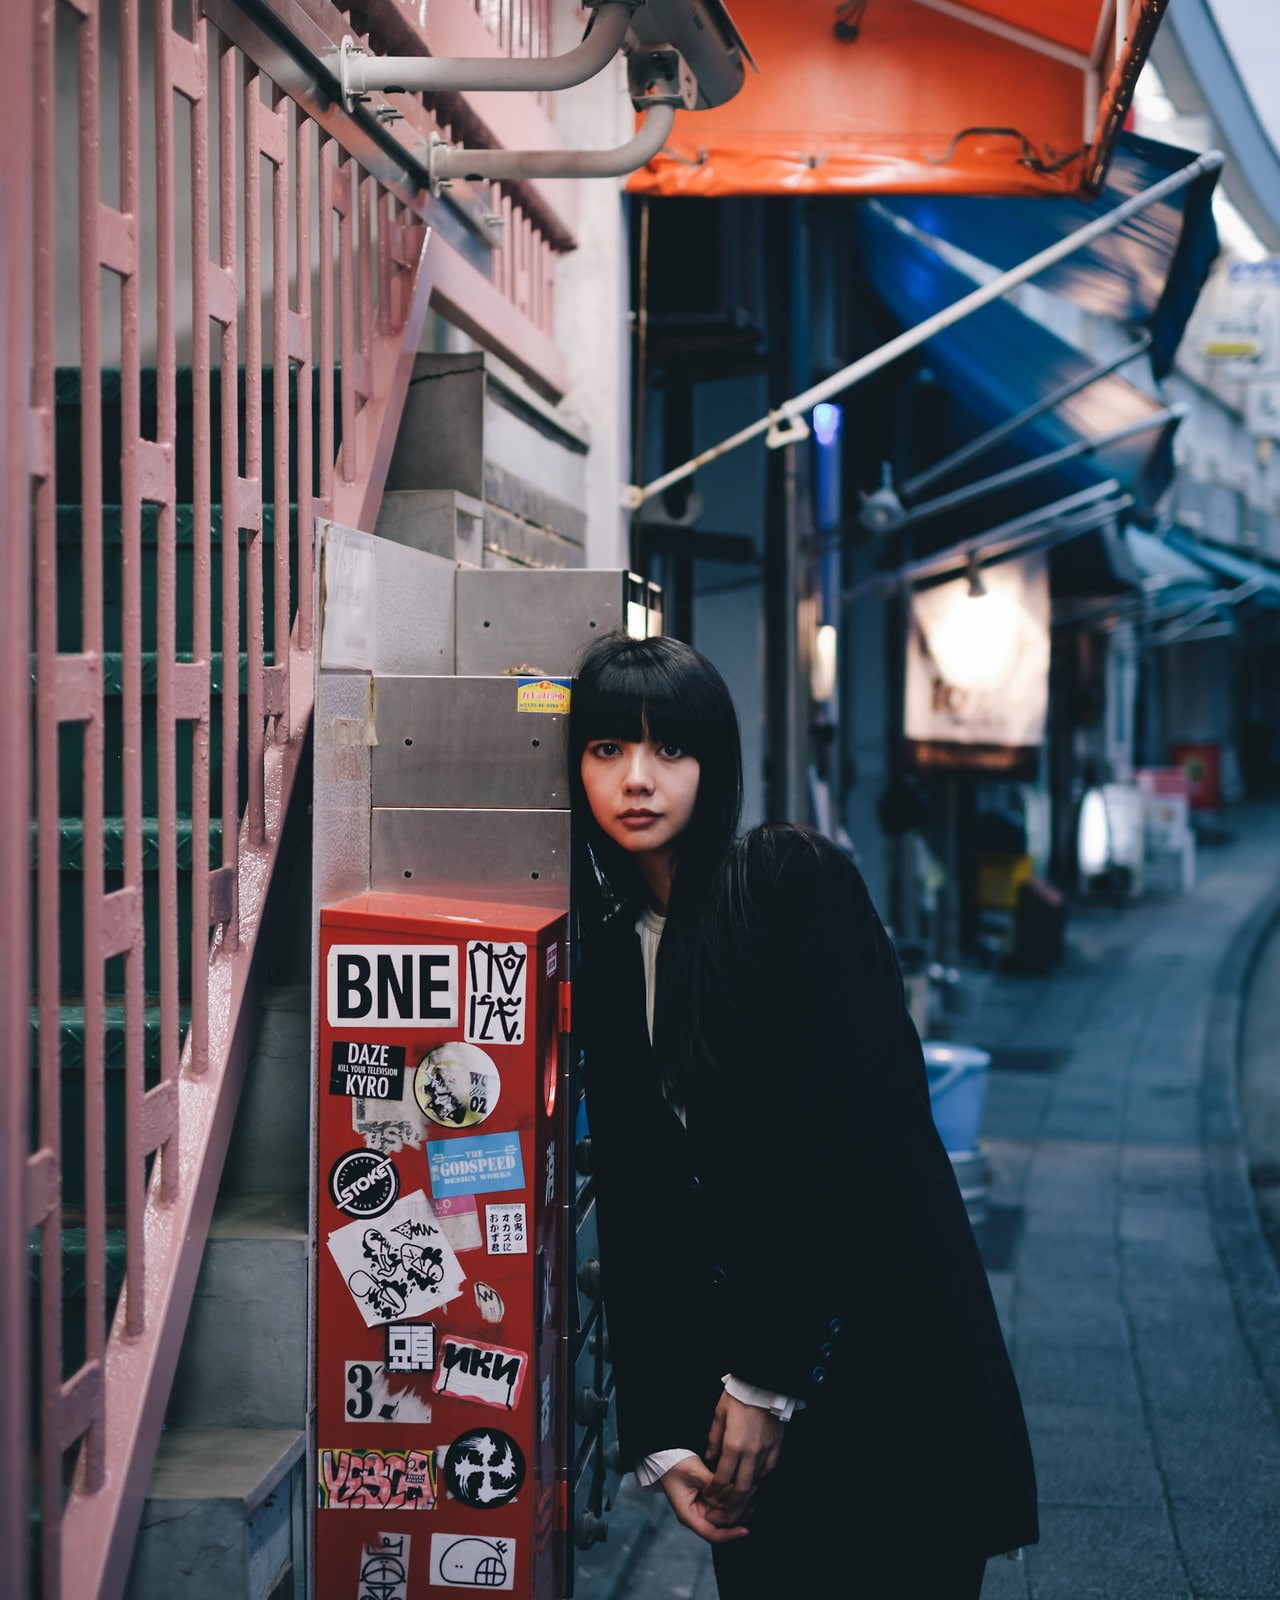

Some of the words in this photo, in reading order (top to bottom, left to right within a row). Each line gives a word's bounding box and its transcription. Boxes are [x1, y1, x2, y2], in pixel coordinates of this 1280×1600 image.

[337, 954, 451, 1019] BNE
[347, 1042, 390, 1066] DAZE
[337, 1063, 350, 1073] KILL
[350, 1064, 366, 1075] YOUR
[367, 1066, 398, 1077] TELEVISION
[345, 1074, 389, 1098] KYRO
[464, 1149, 484, 1159] THE
[440, 1155, 516, 1178] GODSPEED
[444, 1175, 477, 1185] DESIGN
[480, 1171, 512, 1180] WORKS
[337, 1158, 391, 1208] STOKE
